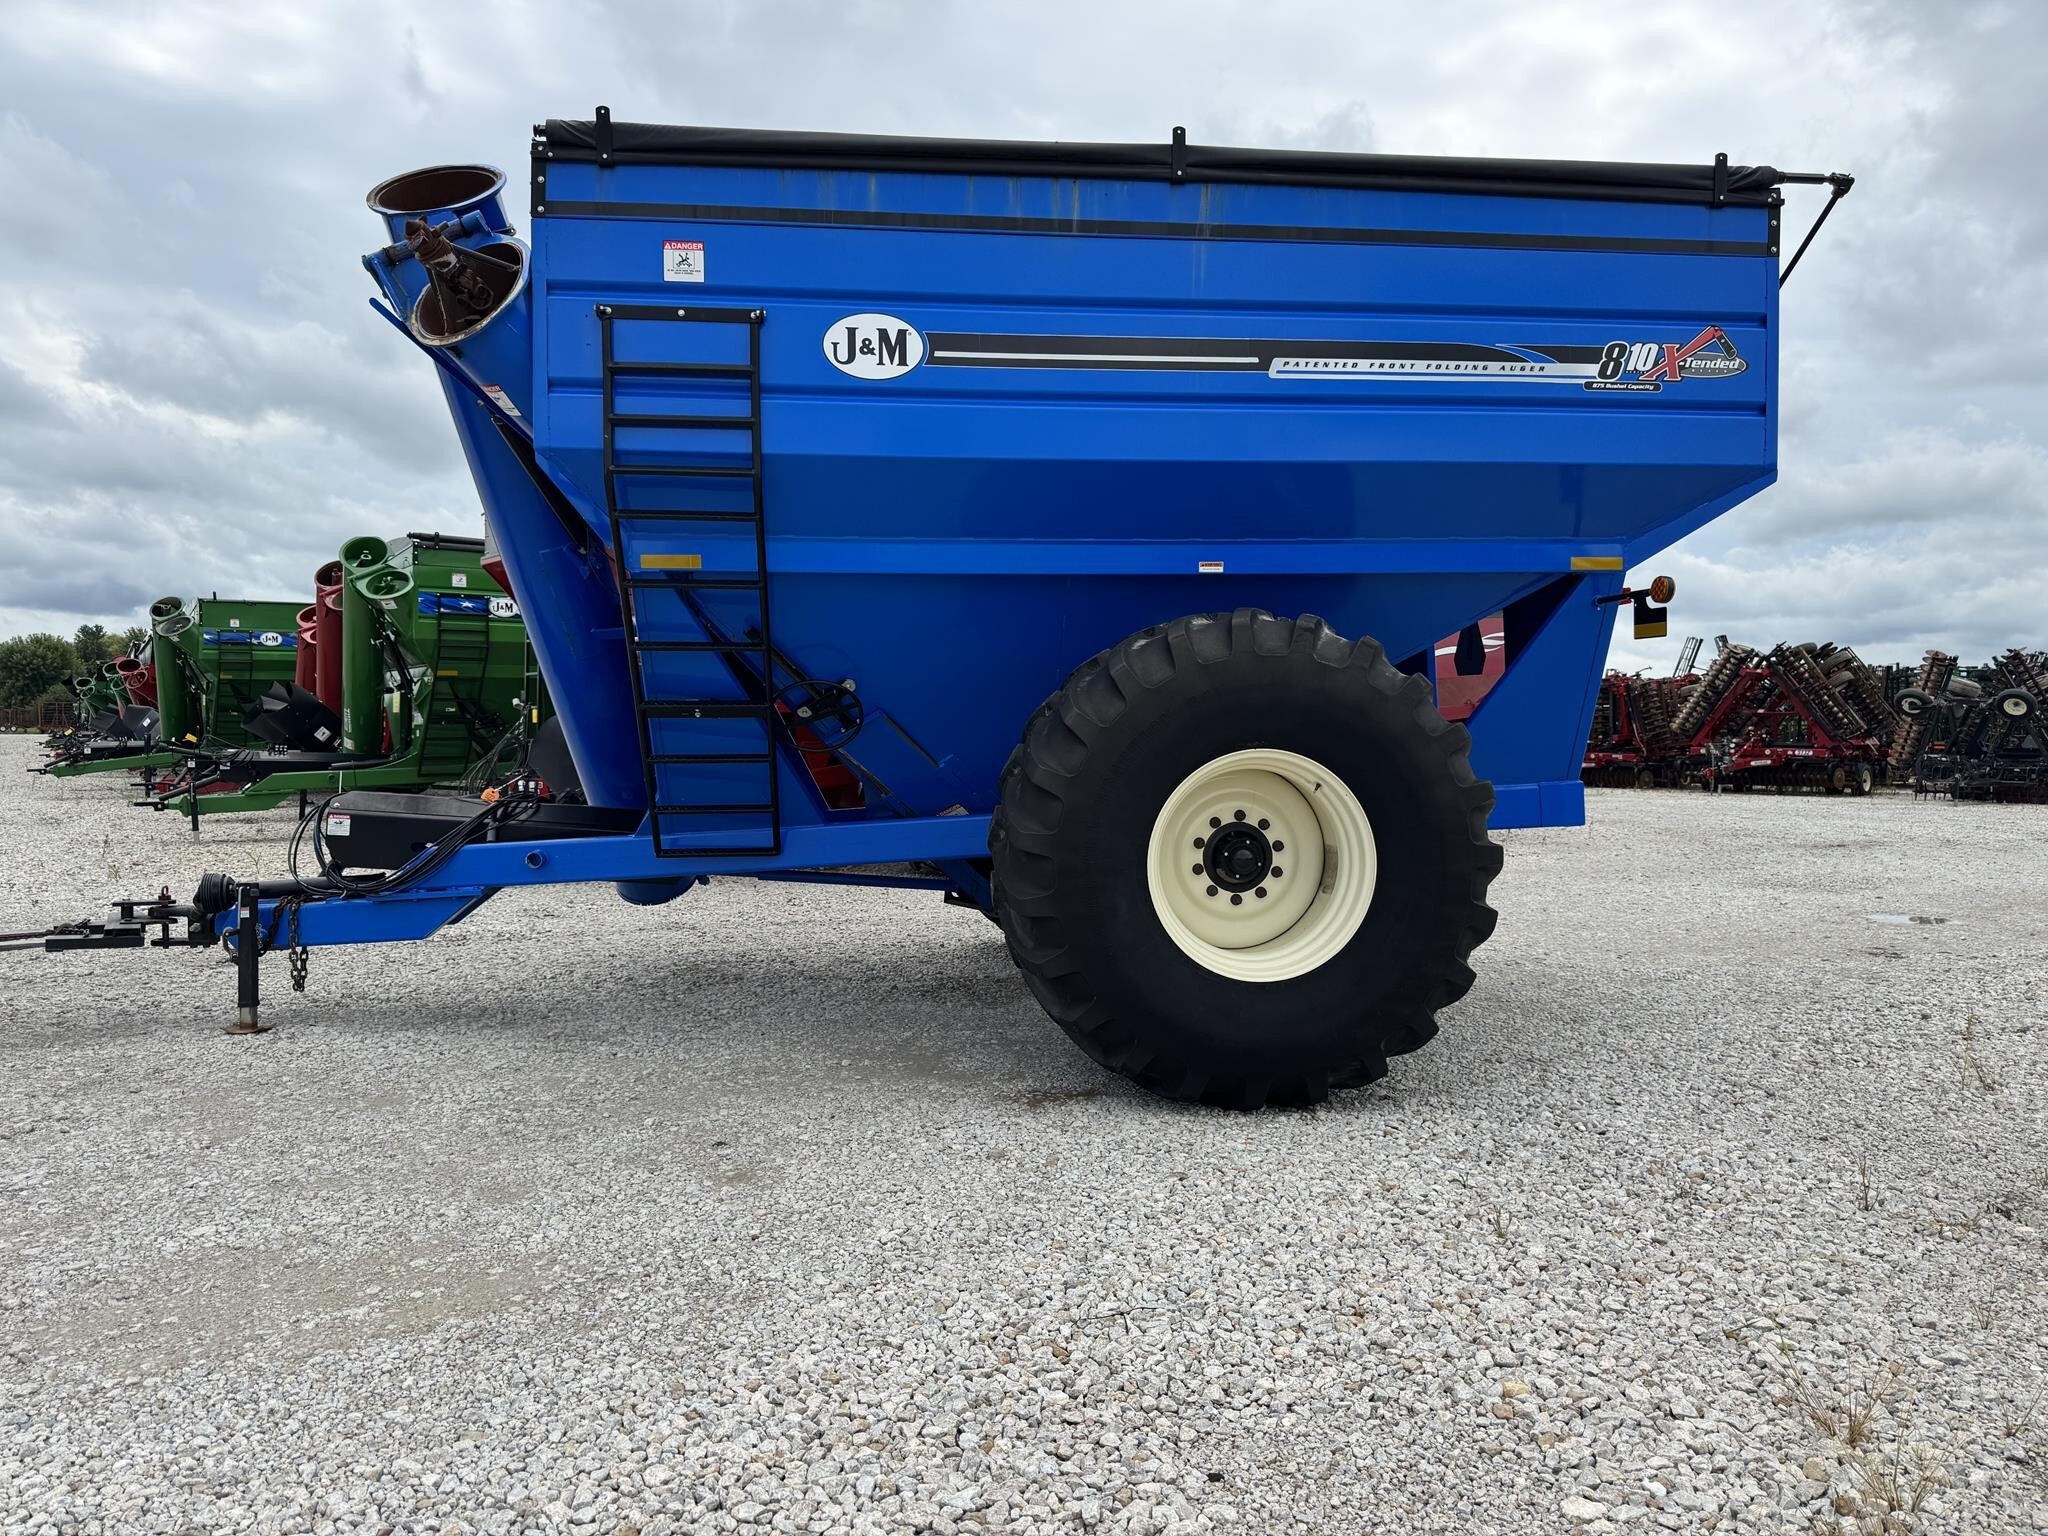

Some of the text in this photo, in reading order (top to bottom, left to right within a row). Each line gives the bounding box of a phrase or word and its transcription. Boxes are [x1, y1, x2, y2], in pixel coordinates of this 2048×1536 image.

[671, 242, 703, 250] DANGER
[831, 326, 909, 367] J&M
[1283, 361, 1359, 369] PATENTED
[1369, 362, 1416, 370] FRONT
[1426, 363, 1489, 371] FOLDING
[492, 602, 513, 613] J&M
